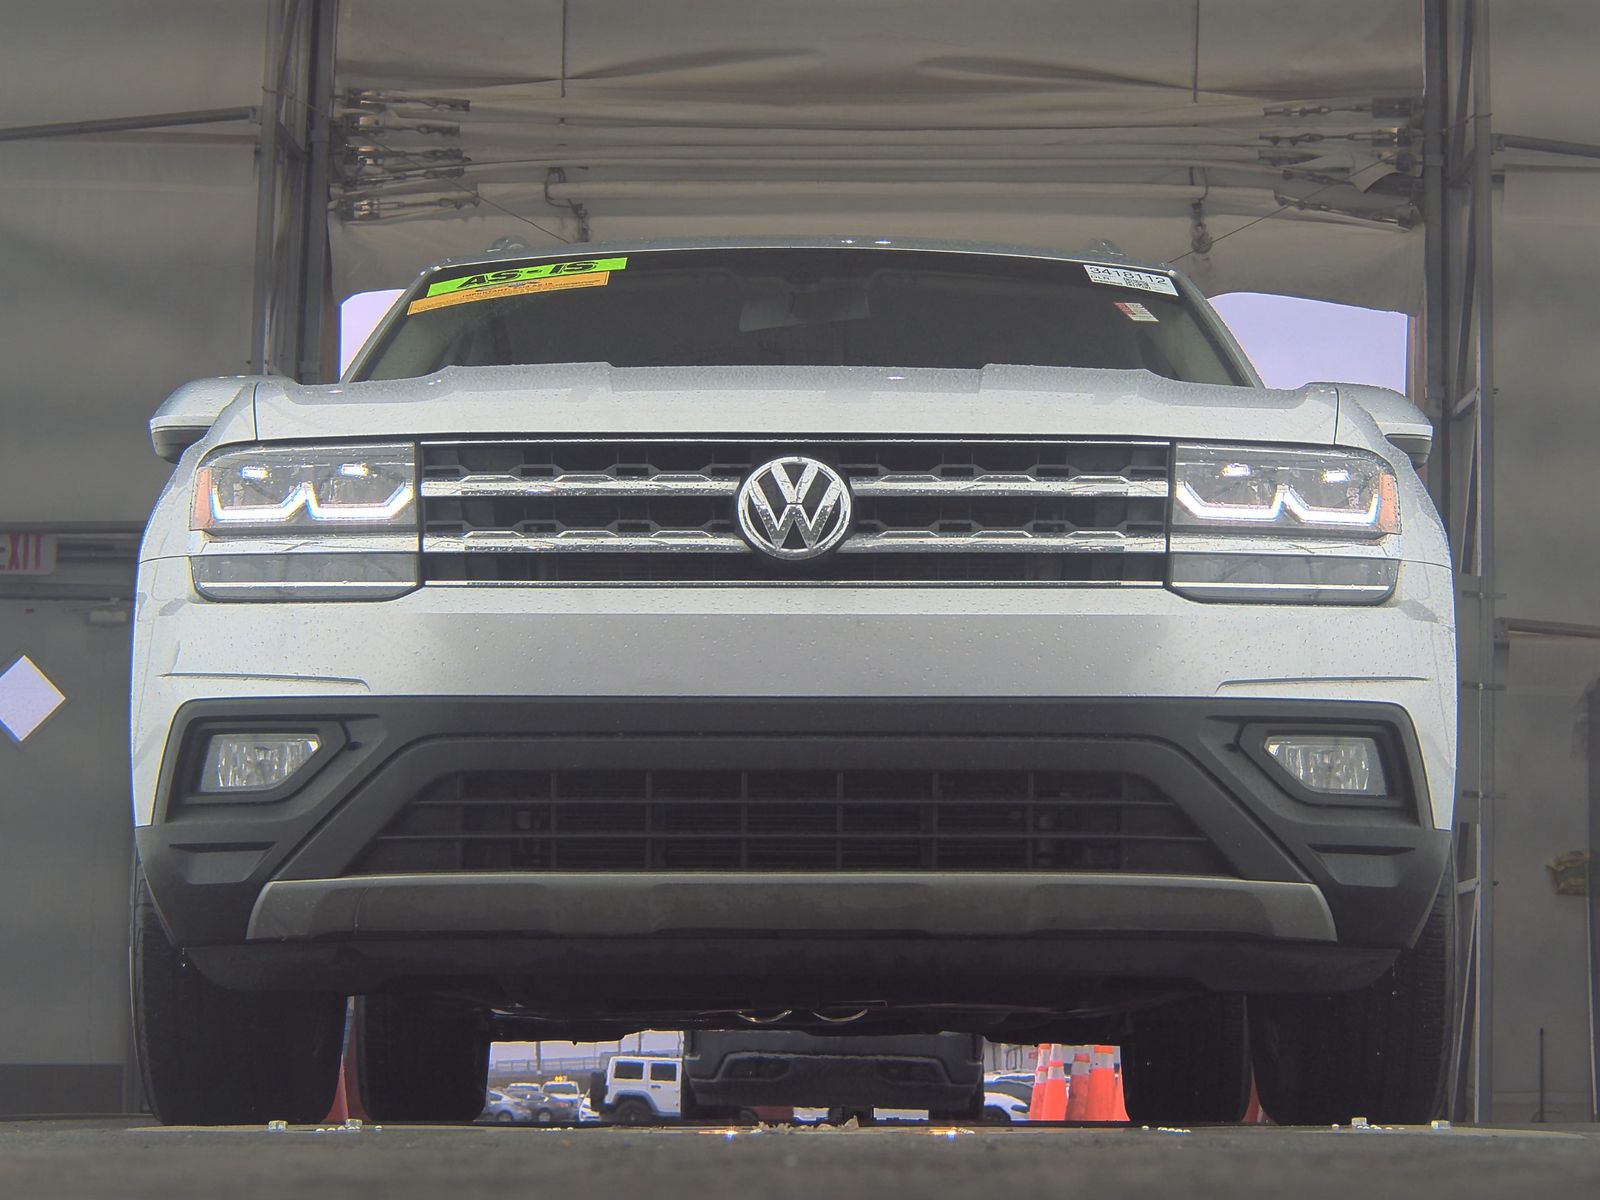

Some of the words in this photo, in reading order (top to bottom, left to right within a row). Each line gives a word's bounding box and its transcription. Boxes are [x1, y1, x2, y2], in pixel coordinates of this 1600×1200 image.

[456, 261, 598, 288] AS-IS
[1089, 266, 1168, 285] 3418112
[743, 459, 845, 554] VW
